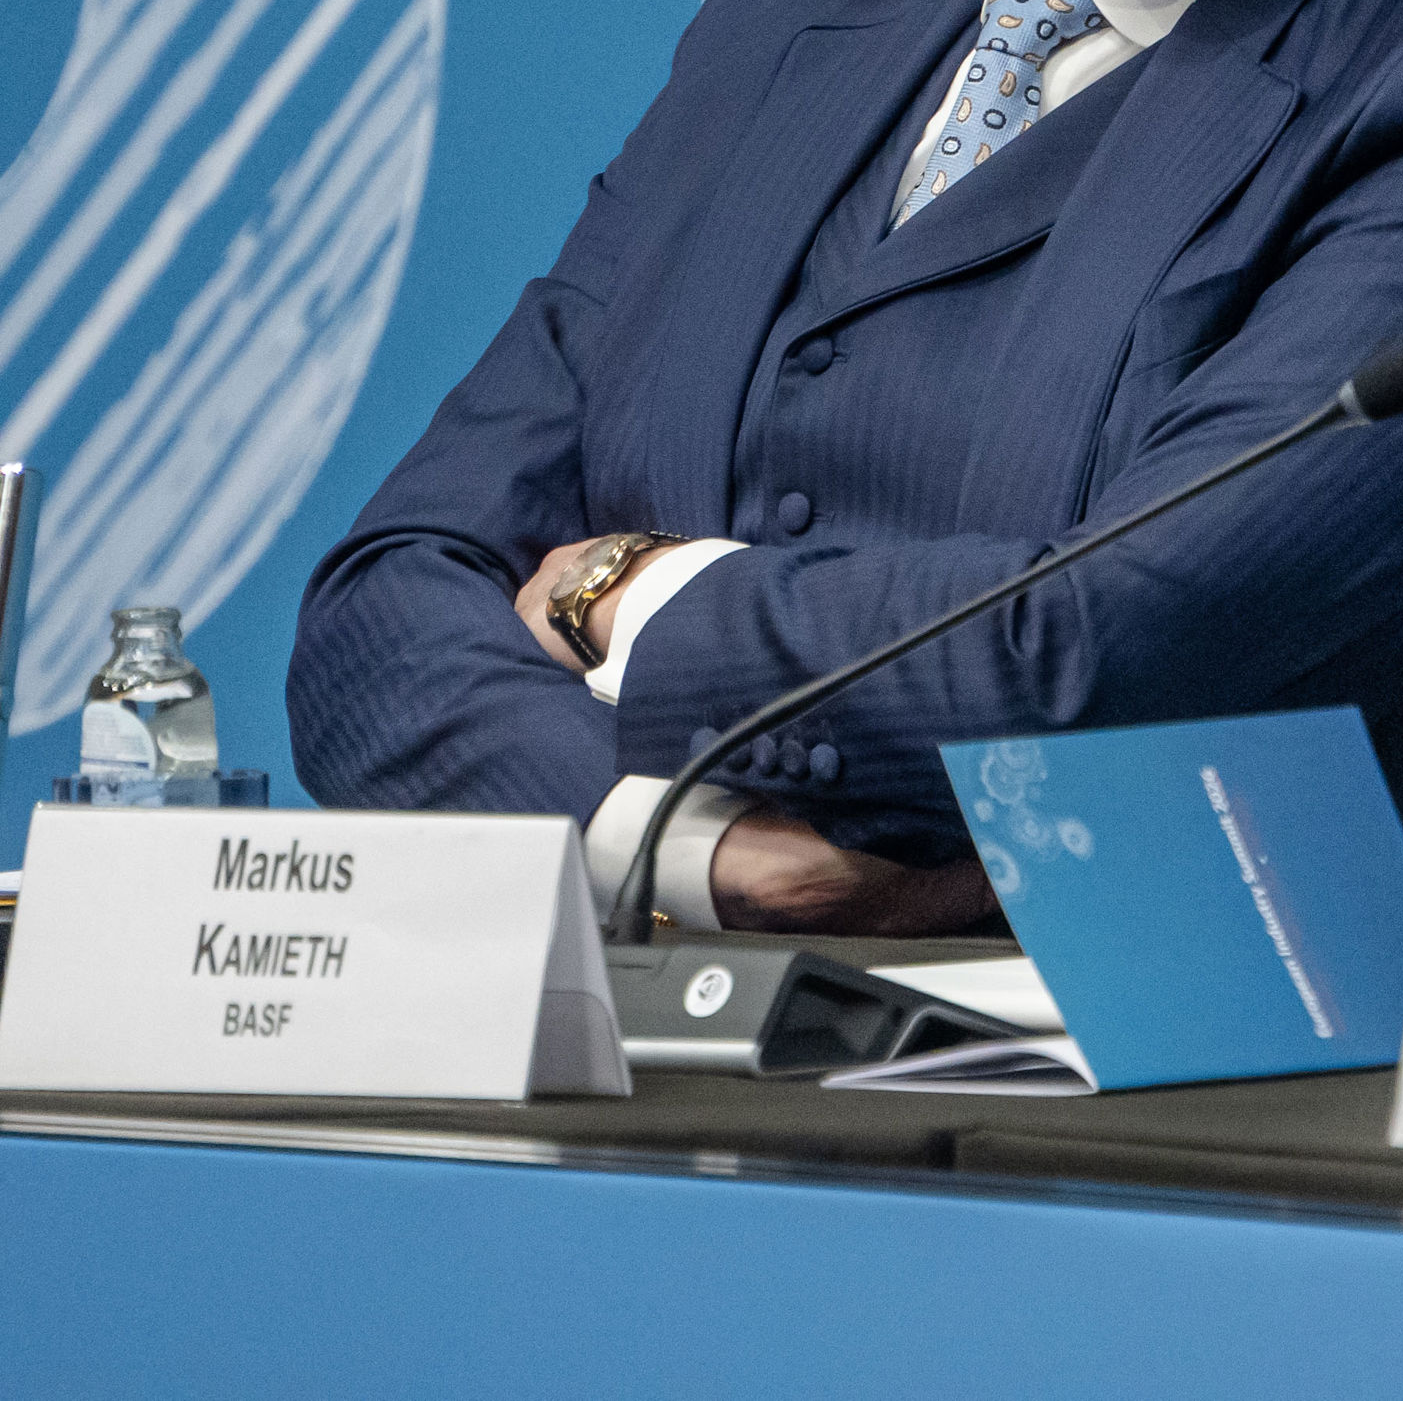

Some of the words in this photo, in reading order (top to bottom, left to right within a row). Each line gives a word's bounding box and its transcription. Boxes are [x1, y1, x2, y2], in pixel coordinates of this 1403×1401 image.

[213, 838, 354, 893] Markus
[1219, 813, 1258, 884] Summit
[192, 923, 348, 979] KAMIETH
[1251, 885, 1292, 957] Industry
[222, 1002, 293, 1038] BASF
[1283, 958, 1333, 1038] European
